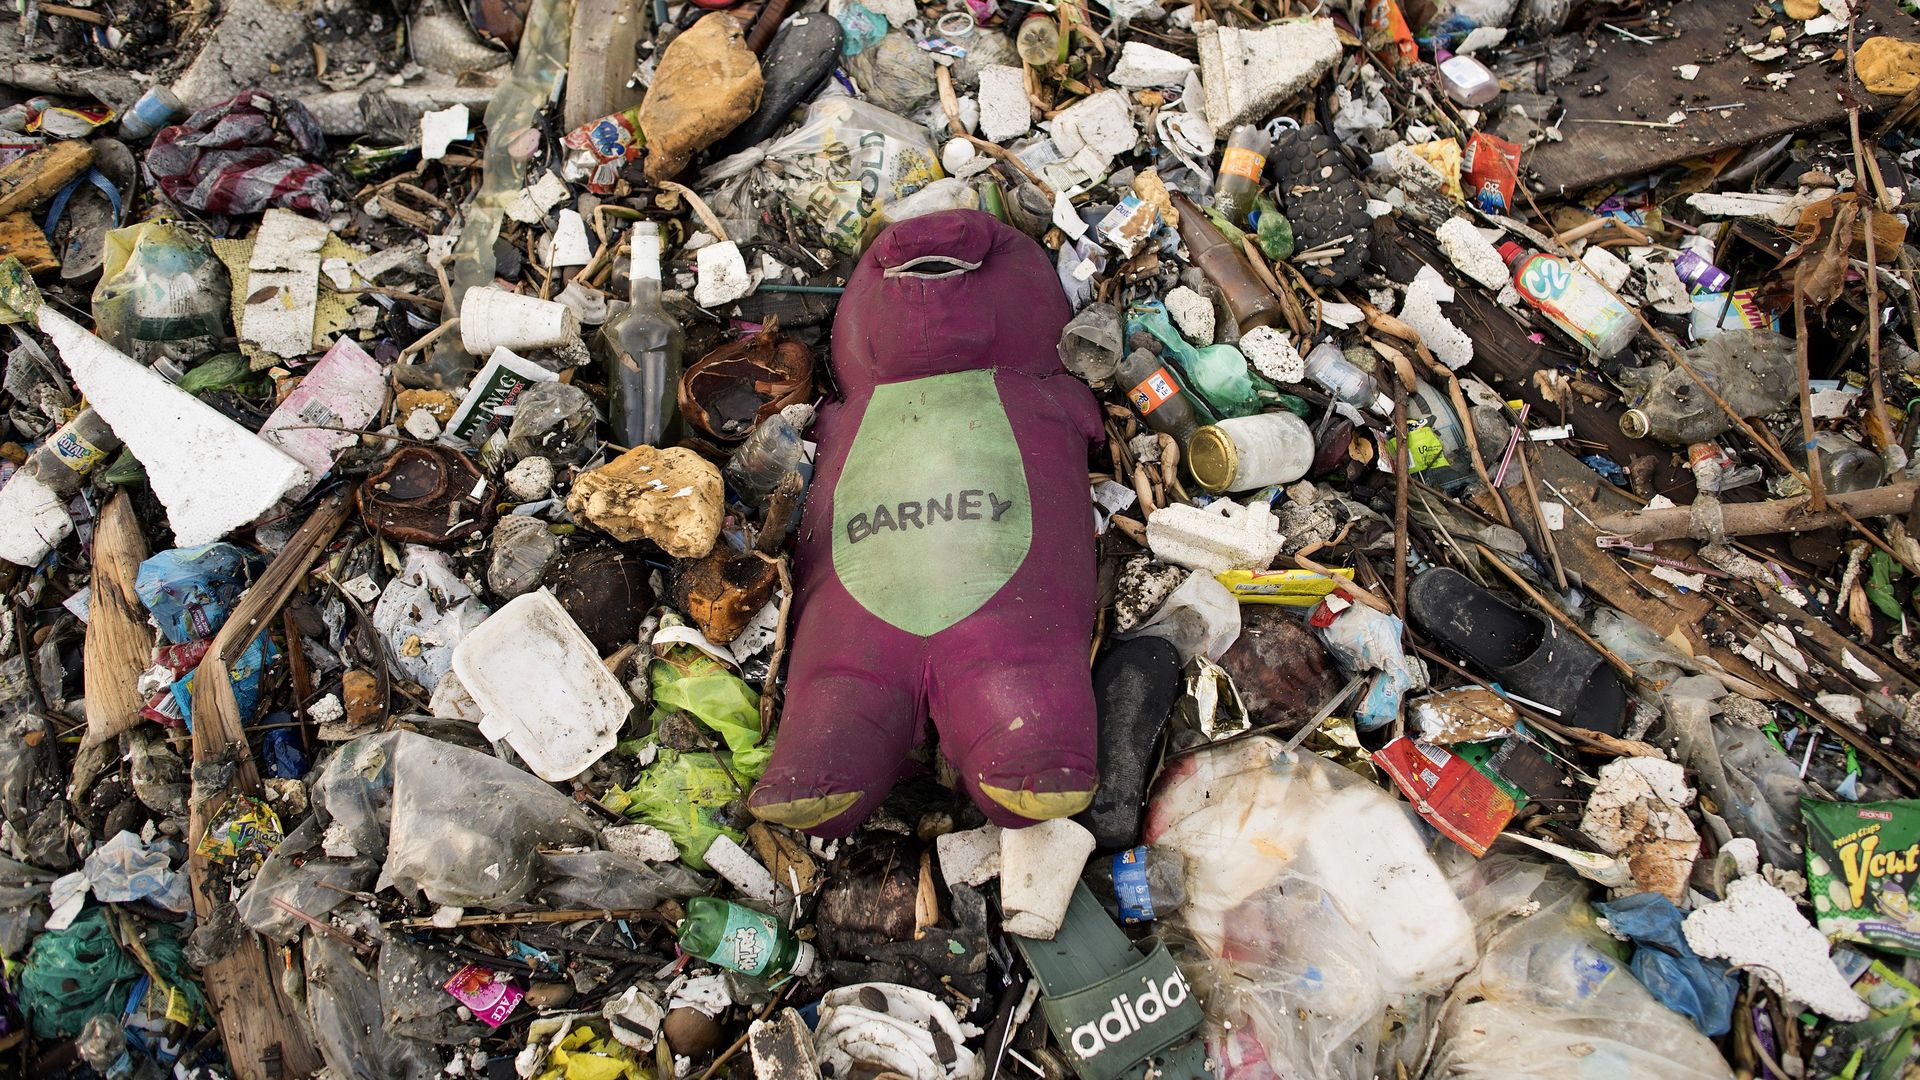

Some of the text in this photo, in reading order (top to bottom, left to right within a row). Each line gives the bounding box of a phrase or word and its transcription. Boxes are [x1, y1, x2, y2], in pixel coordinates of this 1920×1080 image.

[57, 432, 86, 459] ROYAL
[847, 489, 1012, 545] BARNEY
[1857, 823, 1881, 838] Chips
[491, 996, 510, 1021] ACE
